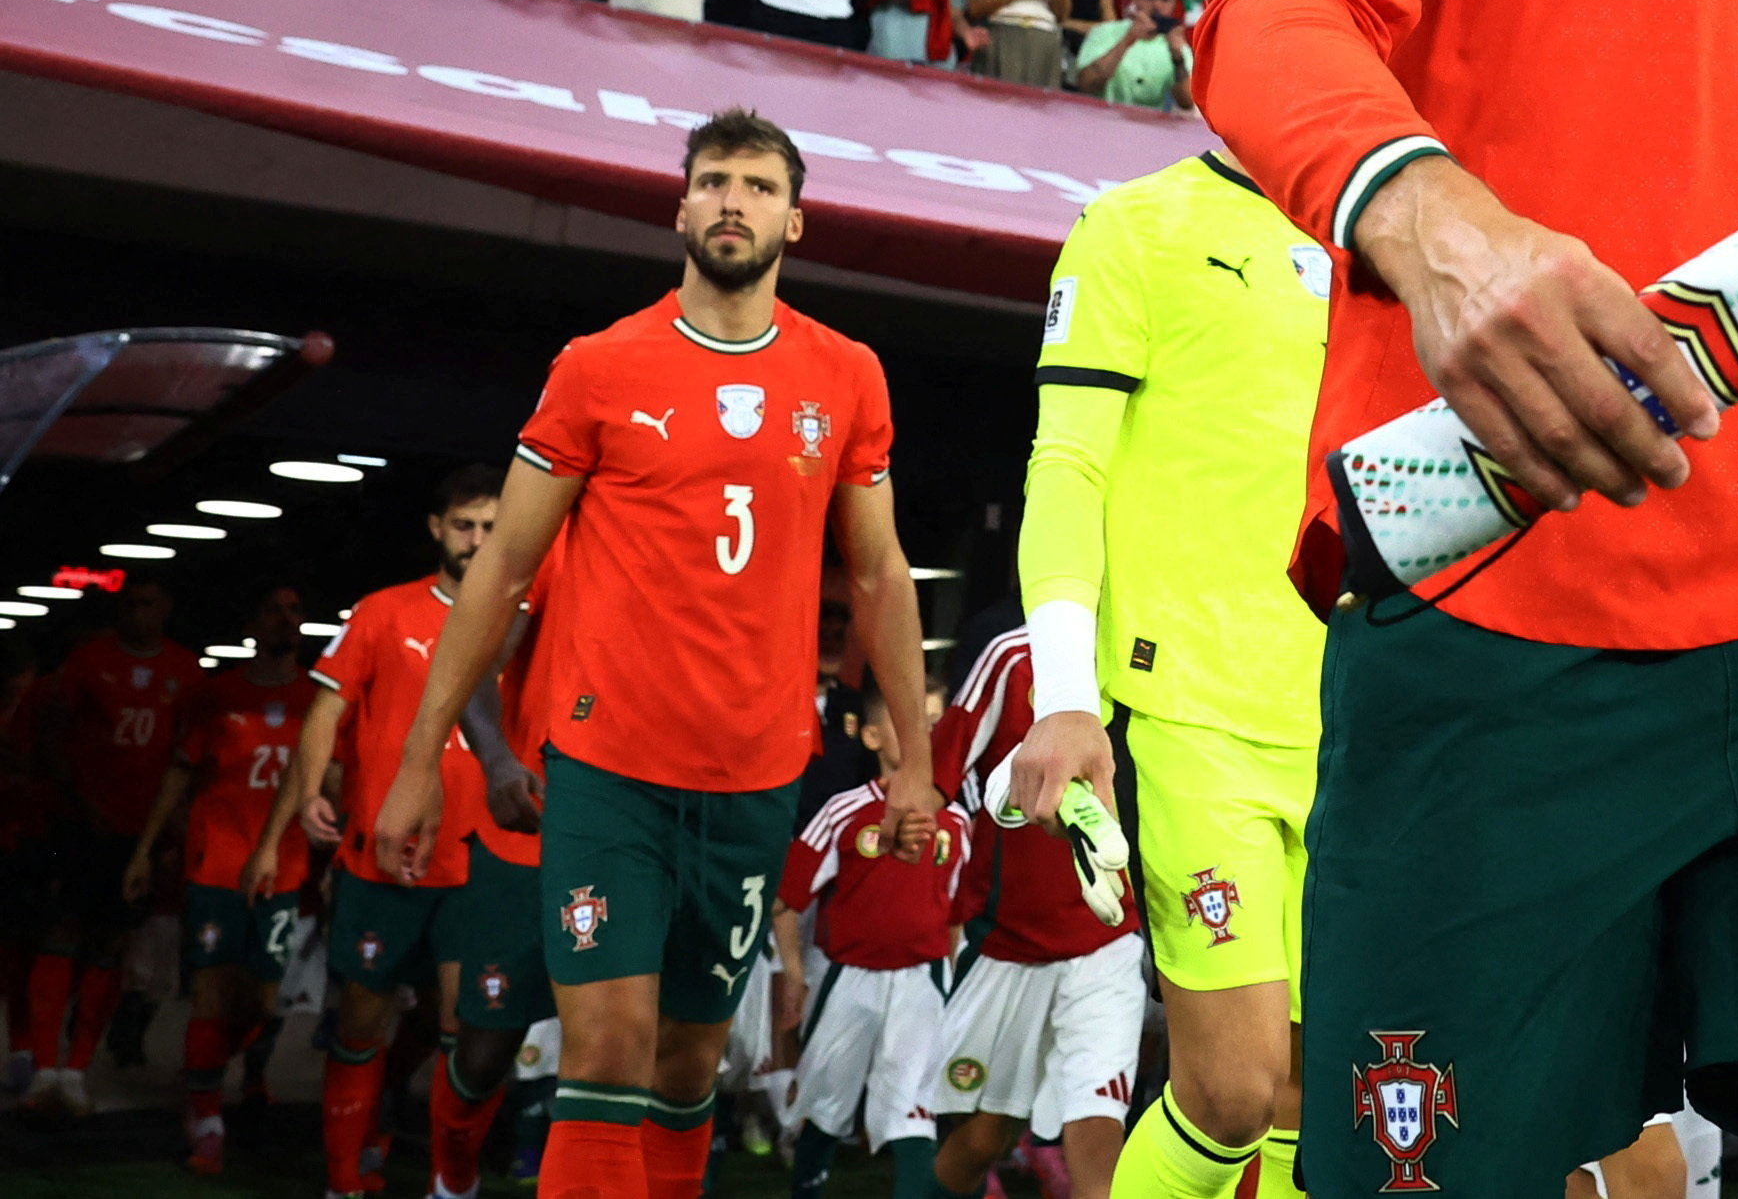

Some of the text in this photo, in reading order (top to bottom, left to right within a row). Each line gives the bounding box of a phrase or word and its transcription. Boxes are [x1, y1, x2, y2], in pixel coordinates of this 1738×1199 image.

[716, 484, 754, 575] 3
[114, 707, 156, 746] 20
[729, 874, 766, 960] 3
